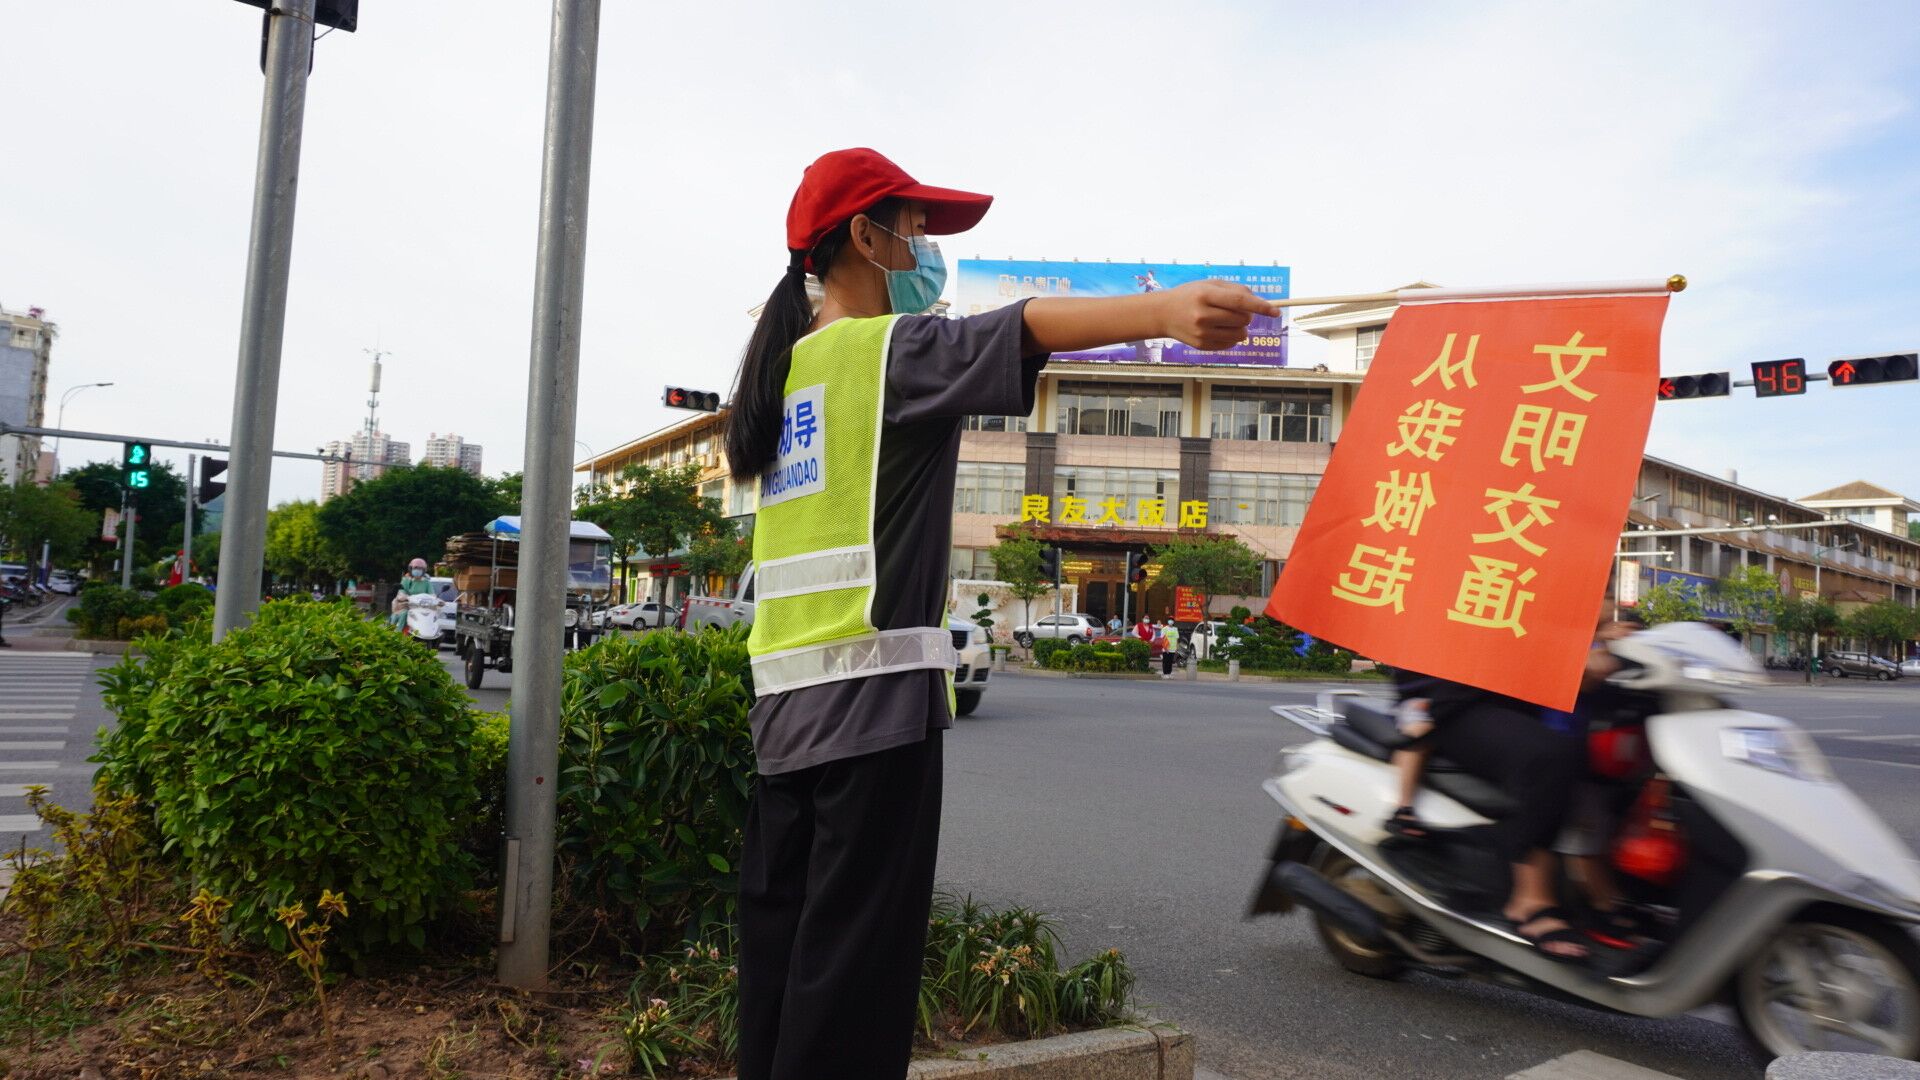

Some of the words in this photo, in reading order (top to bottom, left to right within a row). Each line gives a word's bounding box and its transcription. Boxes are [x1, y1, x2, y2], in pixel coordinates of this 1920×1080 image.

[1252, 336, 1281, 347] 9699
[1756, 362, 1801, 393] 46
[130, 471, 148, 488] 15
[1021, 494, 1209, 529] 良友大饭店
